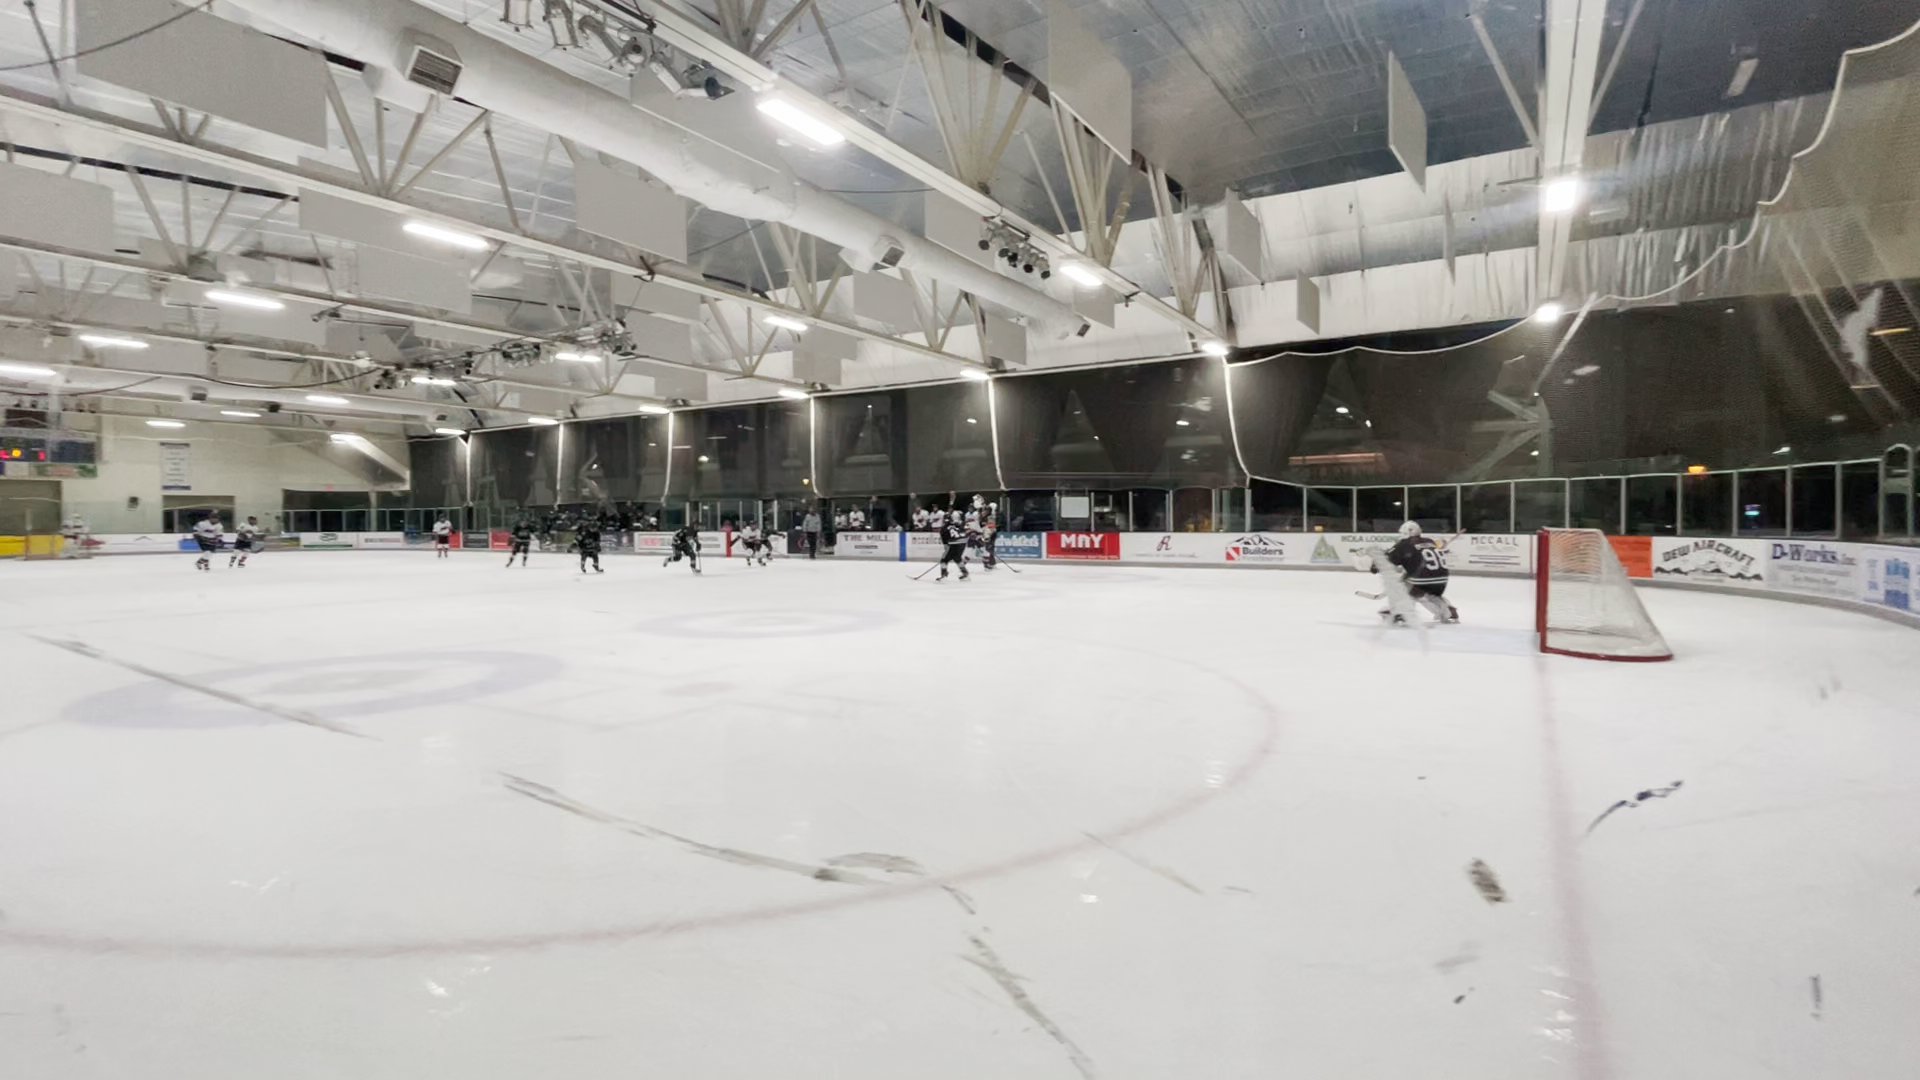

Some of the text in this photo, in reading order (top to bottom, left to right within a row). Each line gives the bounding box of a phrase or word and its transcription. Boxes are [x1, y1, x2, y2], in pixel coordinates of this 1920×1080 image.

[1060, 533, 1104, 548] MAY
[1242, 546, 1284, 556] Builders
[1662, 539, 1755, 566] DEW AIRCRAFT
